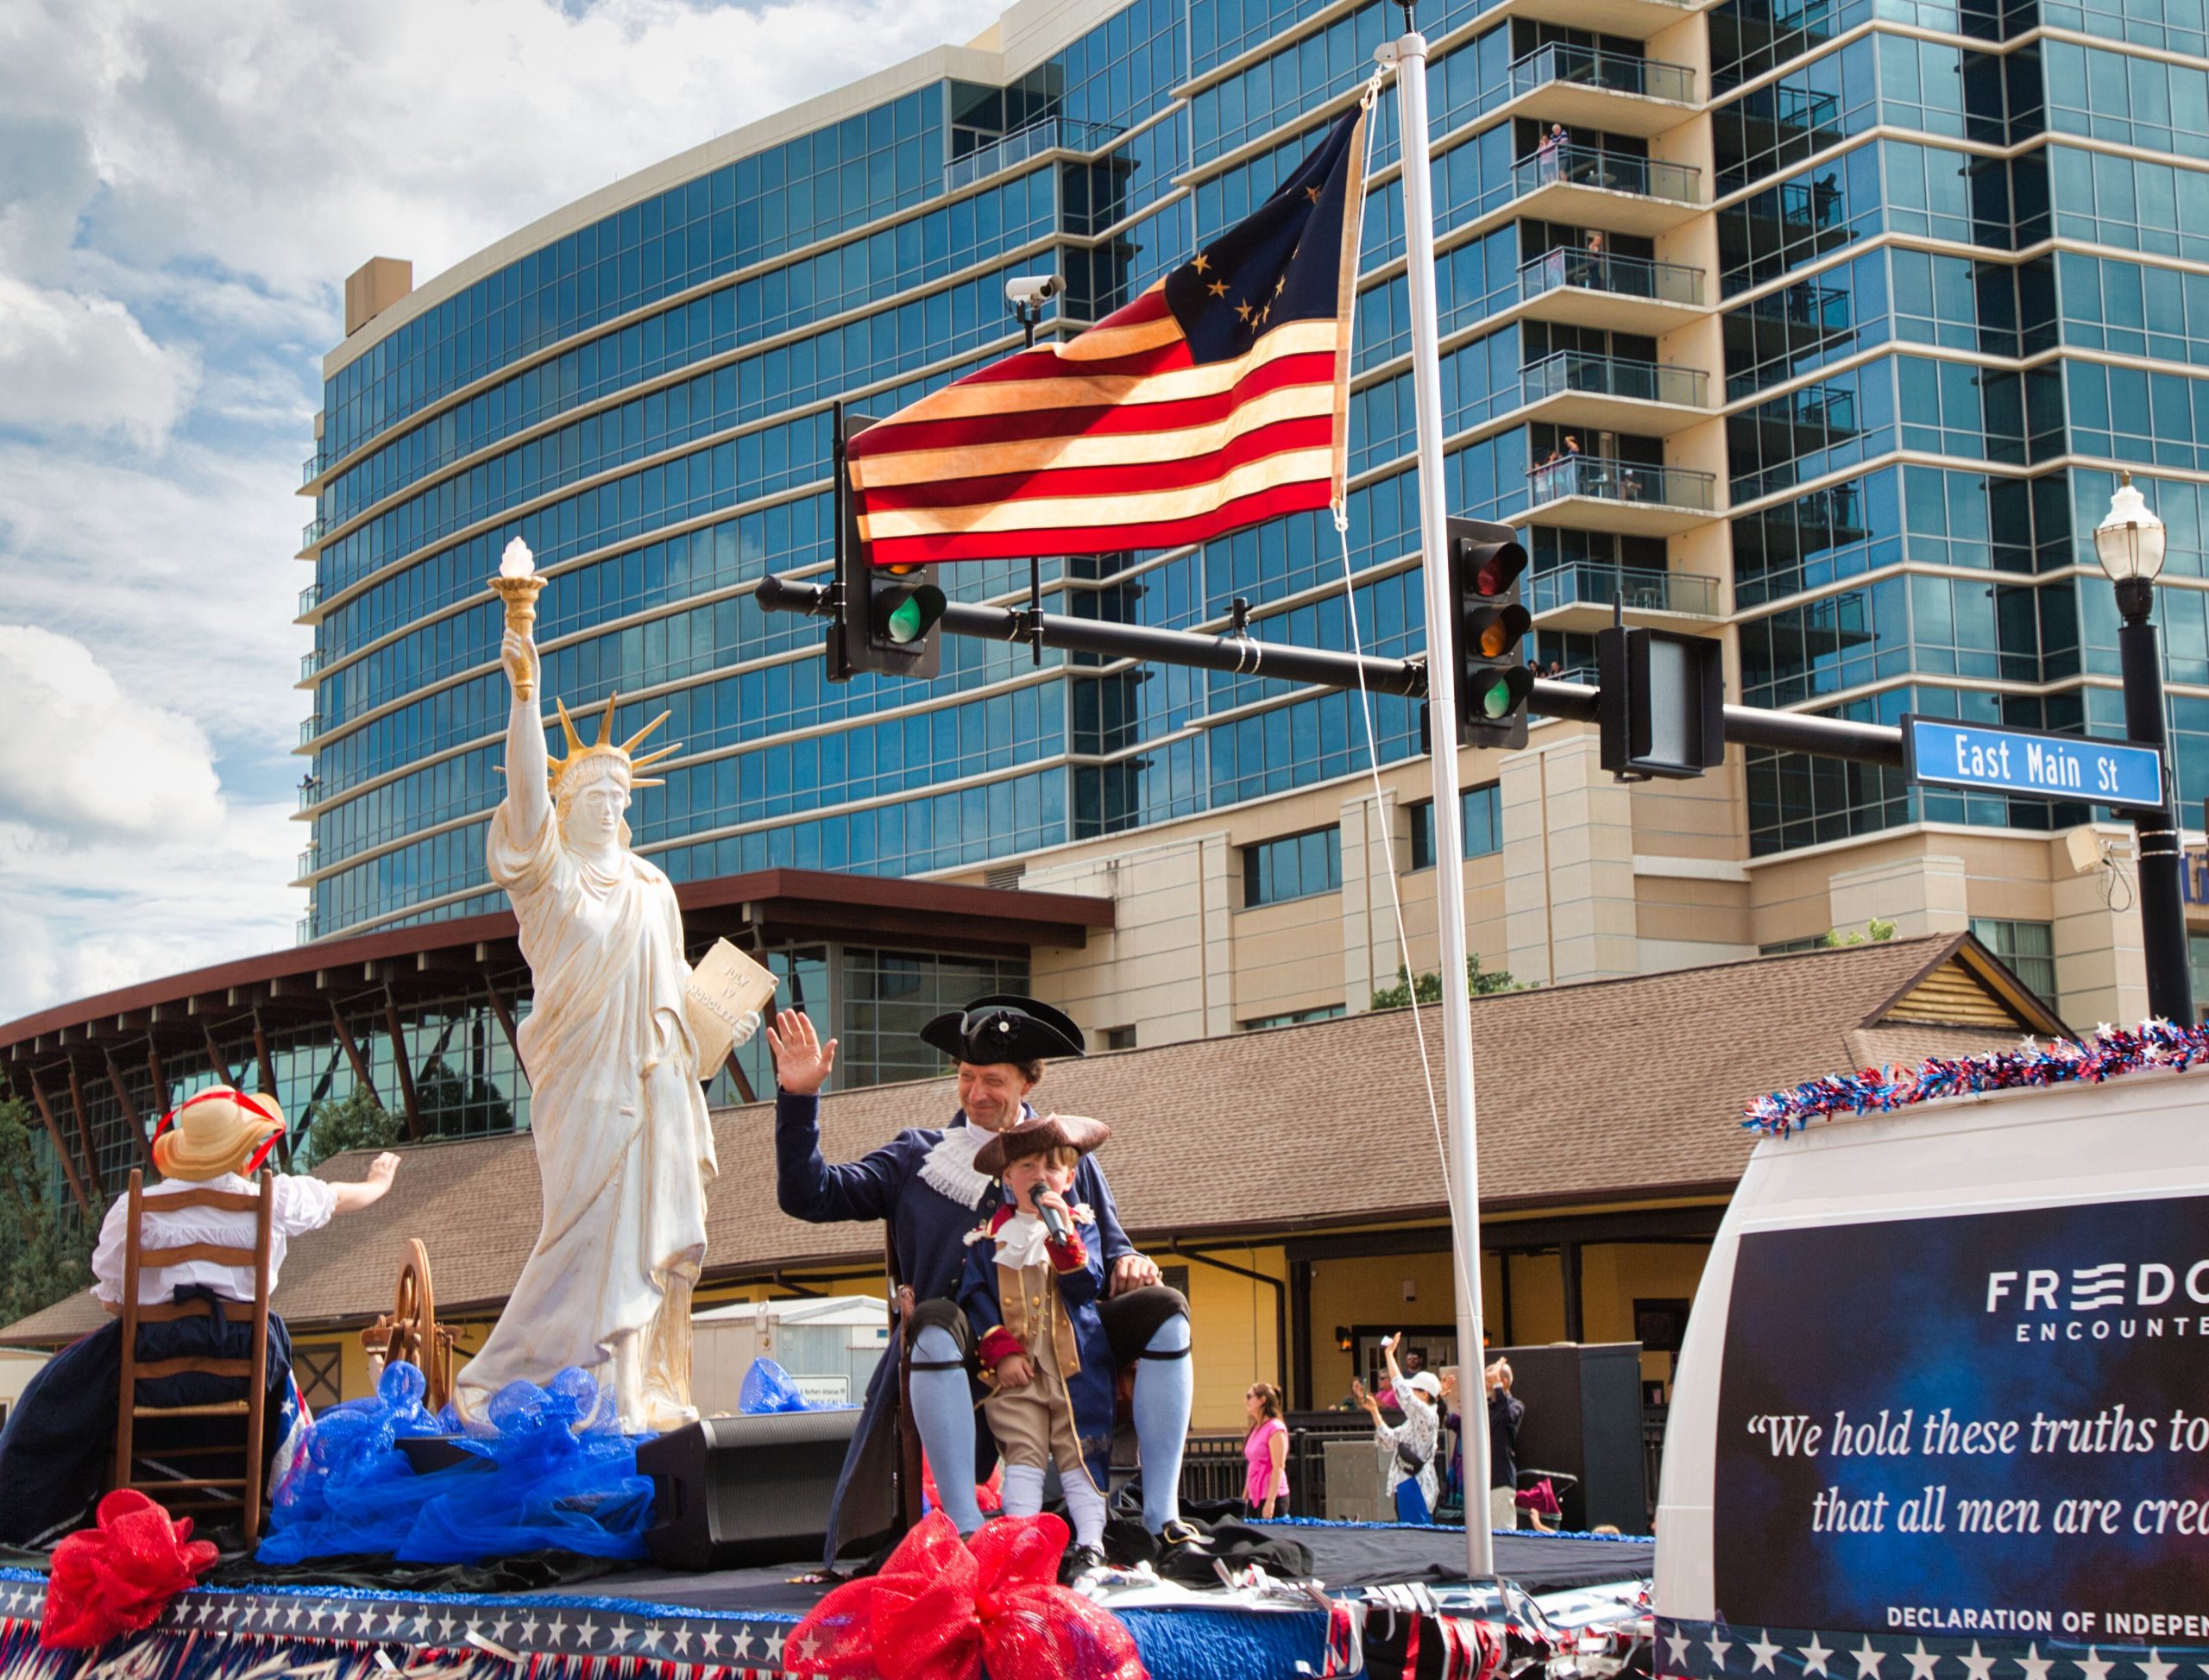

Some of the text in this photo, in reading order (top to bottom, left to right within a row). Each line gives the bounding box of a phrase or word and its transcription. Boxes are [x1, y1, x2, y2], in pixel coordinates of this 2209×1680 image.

[1955, 734, 2119, 792] East Main St
[2017, 1317, 2209, 1342] ENCOUNTE
[1831, 1408, 1914, 1457] hold
[1923, 1407, 2019, 1455] these
[2030, 1403, 2158, 1453] truths
[2168, 1408, 2209, 1453] to
[1811, 1485, 1890, 1533] that
[1897, 1484, 1947, 1533] all
[1956, 1499, 2042, 1534] men
[2053, 1499, 2122, 1535] are
[1886, 1607, 2053, 1632] DECLARATION
[2061, 1611, 2096, 1633] OF
